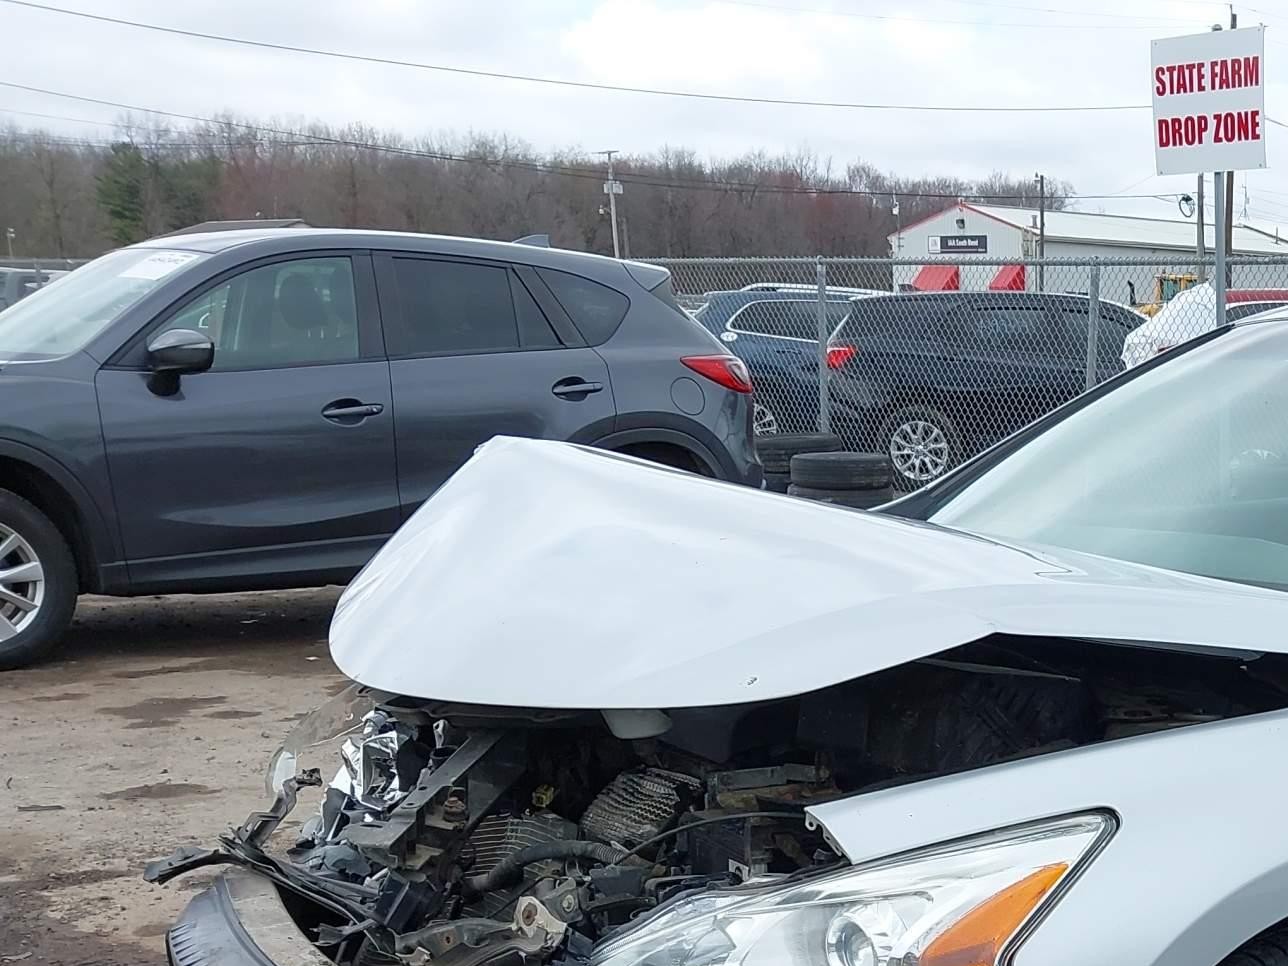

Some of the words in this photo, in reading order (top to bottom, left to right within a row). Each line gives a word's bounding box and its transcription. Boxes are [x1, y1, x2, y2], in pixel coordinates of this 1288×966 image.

[1155, 62, 1206, 96] STATE
[1210, 56, 1260, 91] FARM
[1158, 115, 1208, 147] DROP
[1213, 110, 1260, 143] ZONE
